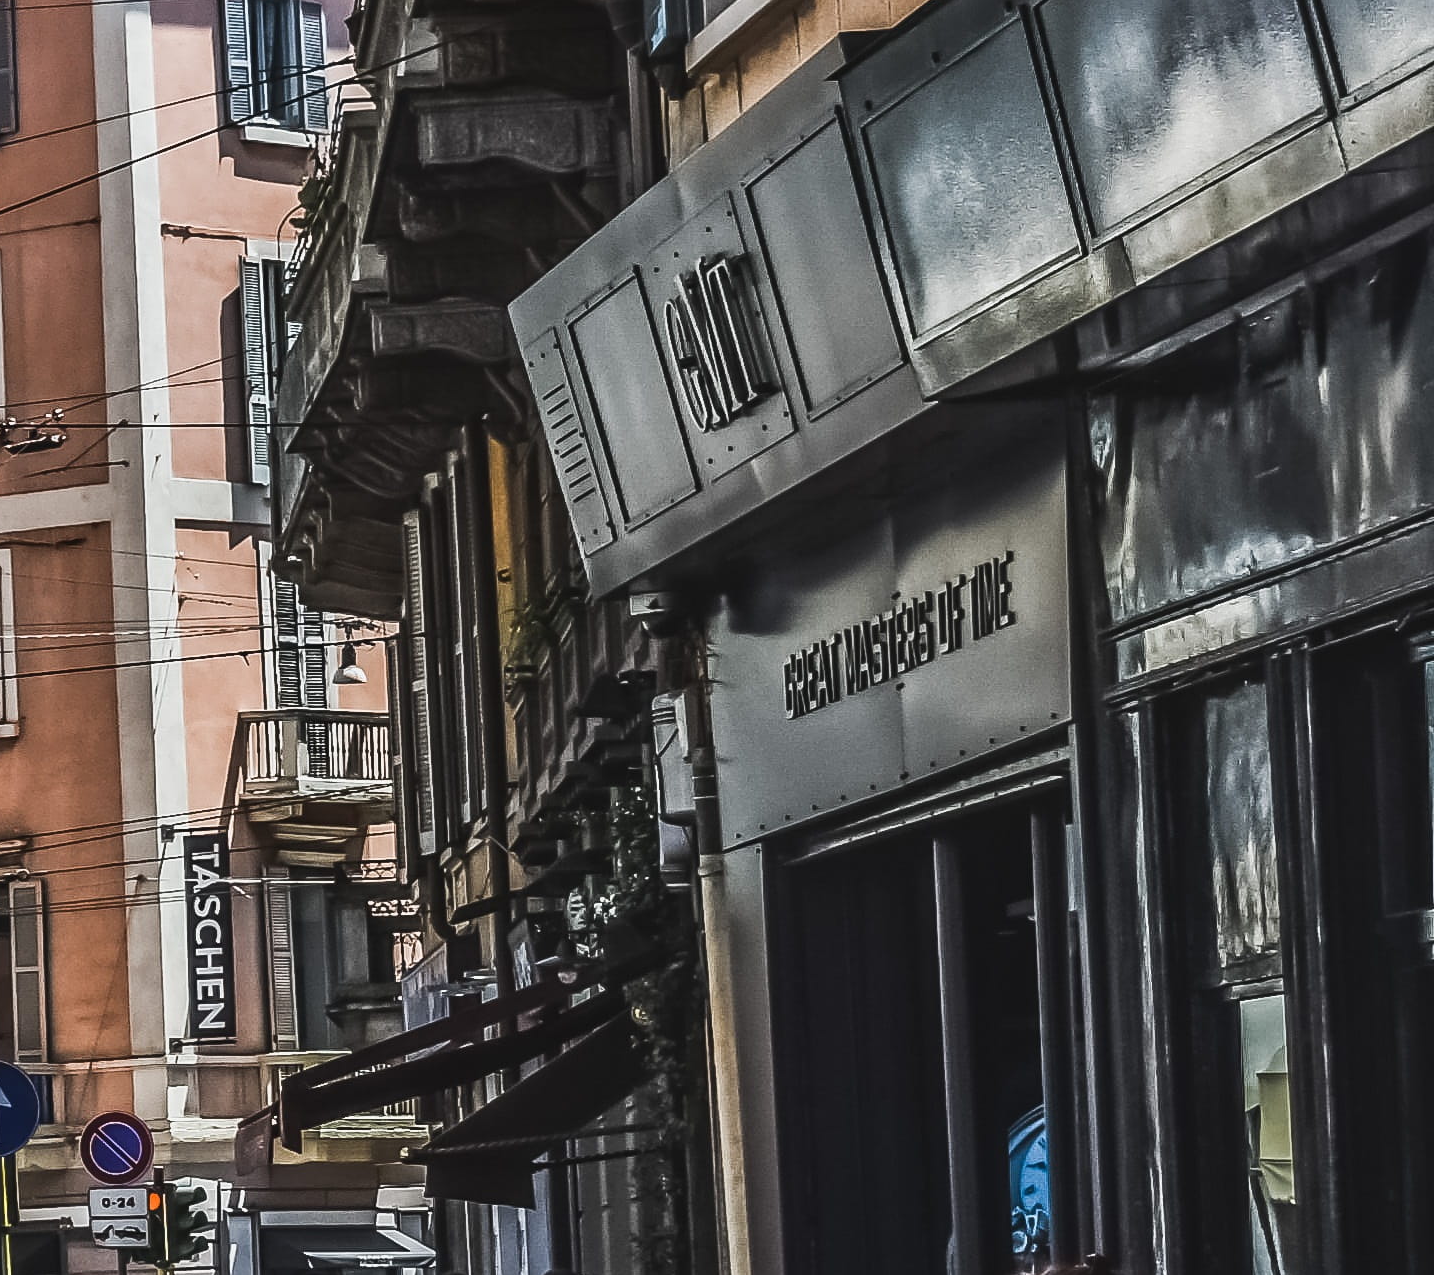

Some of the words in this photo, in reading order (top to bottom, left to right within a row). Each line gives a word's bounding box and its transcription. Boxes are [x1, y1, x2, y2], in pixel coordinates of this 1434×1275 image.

[784, 632, 842, 719] GREAT
[843, 591, 935, 696] MASTERS
[969, 550, 1016, 641] TIME
[191, 843, 227, 1030] TASCHEN
[101, 1196, 136, 1209] 0-24
